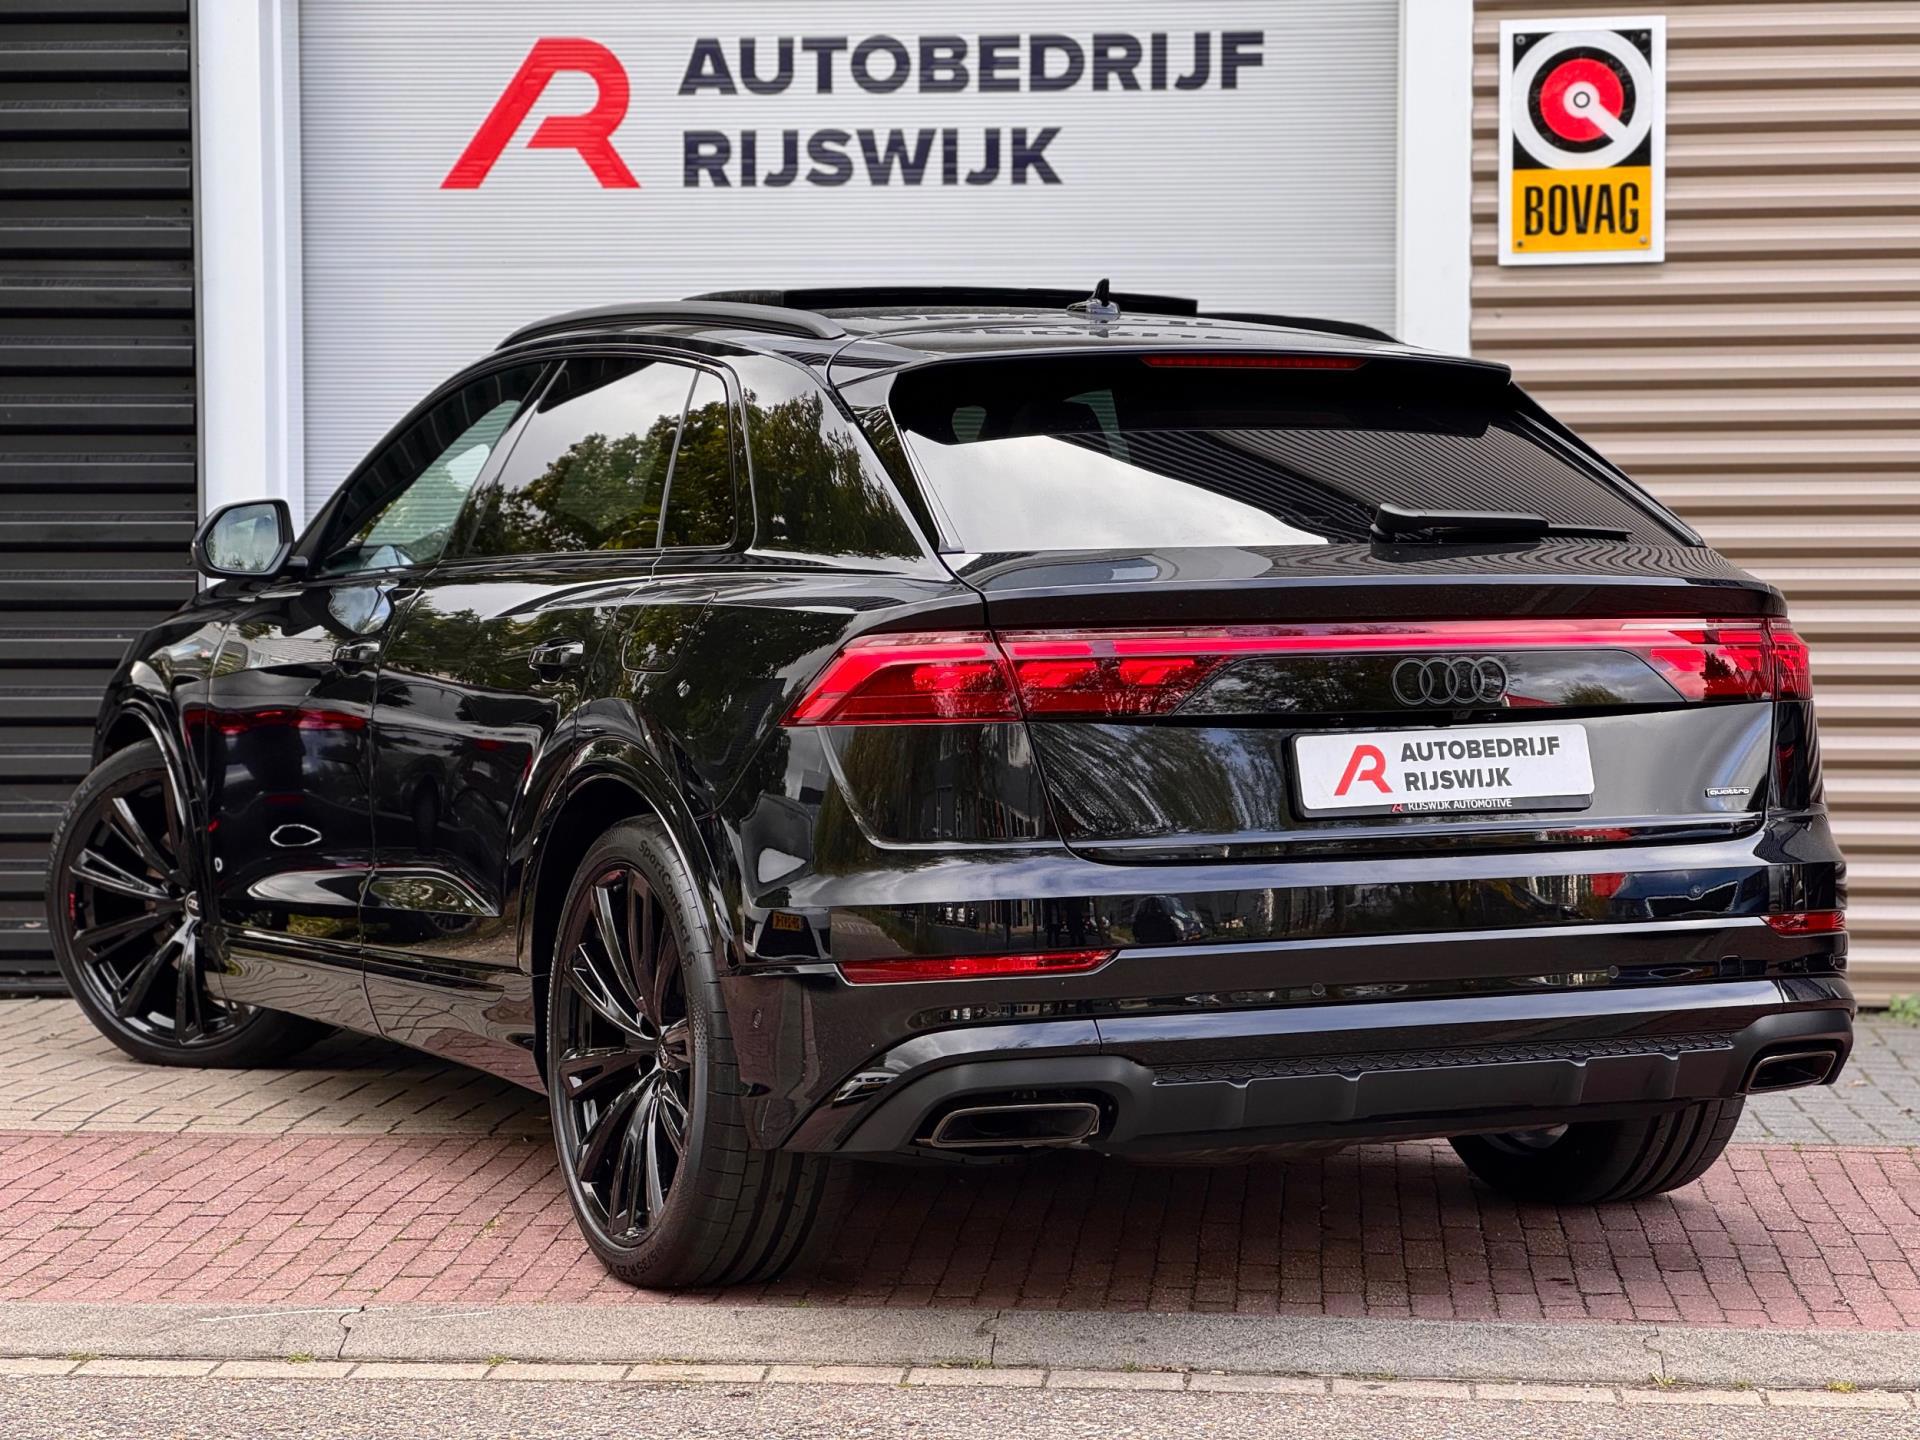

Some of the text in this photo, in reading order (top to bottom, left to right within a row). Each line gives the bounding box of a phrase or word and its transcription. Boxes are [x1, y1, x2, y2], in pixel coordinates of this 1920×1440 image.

[679, 31, 1264, 95] AUTOBEDRIJF
[684, 127, 1062, 188] RIJSWIJK
[1524, 182, 1639, 236] BOVAG
[1400, 736, 1560, 762] AUTOBEDRIJF
[1404, 768, 1512, 792] RIJSWIJK
[1709, 788, 1749, 796] quattro
[1408, 801, 1451, 811] RIJSWIJK
[1453, 798, 1513, 809] AUTOMOTIVE
[638, 840, 696, 967] SportContact 6
